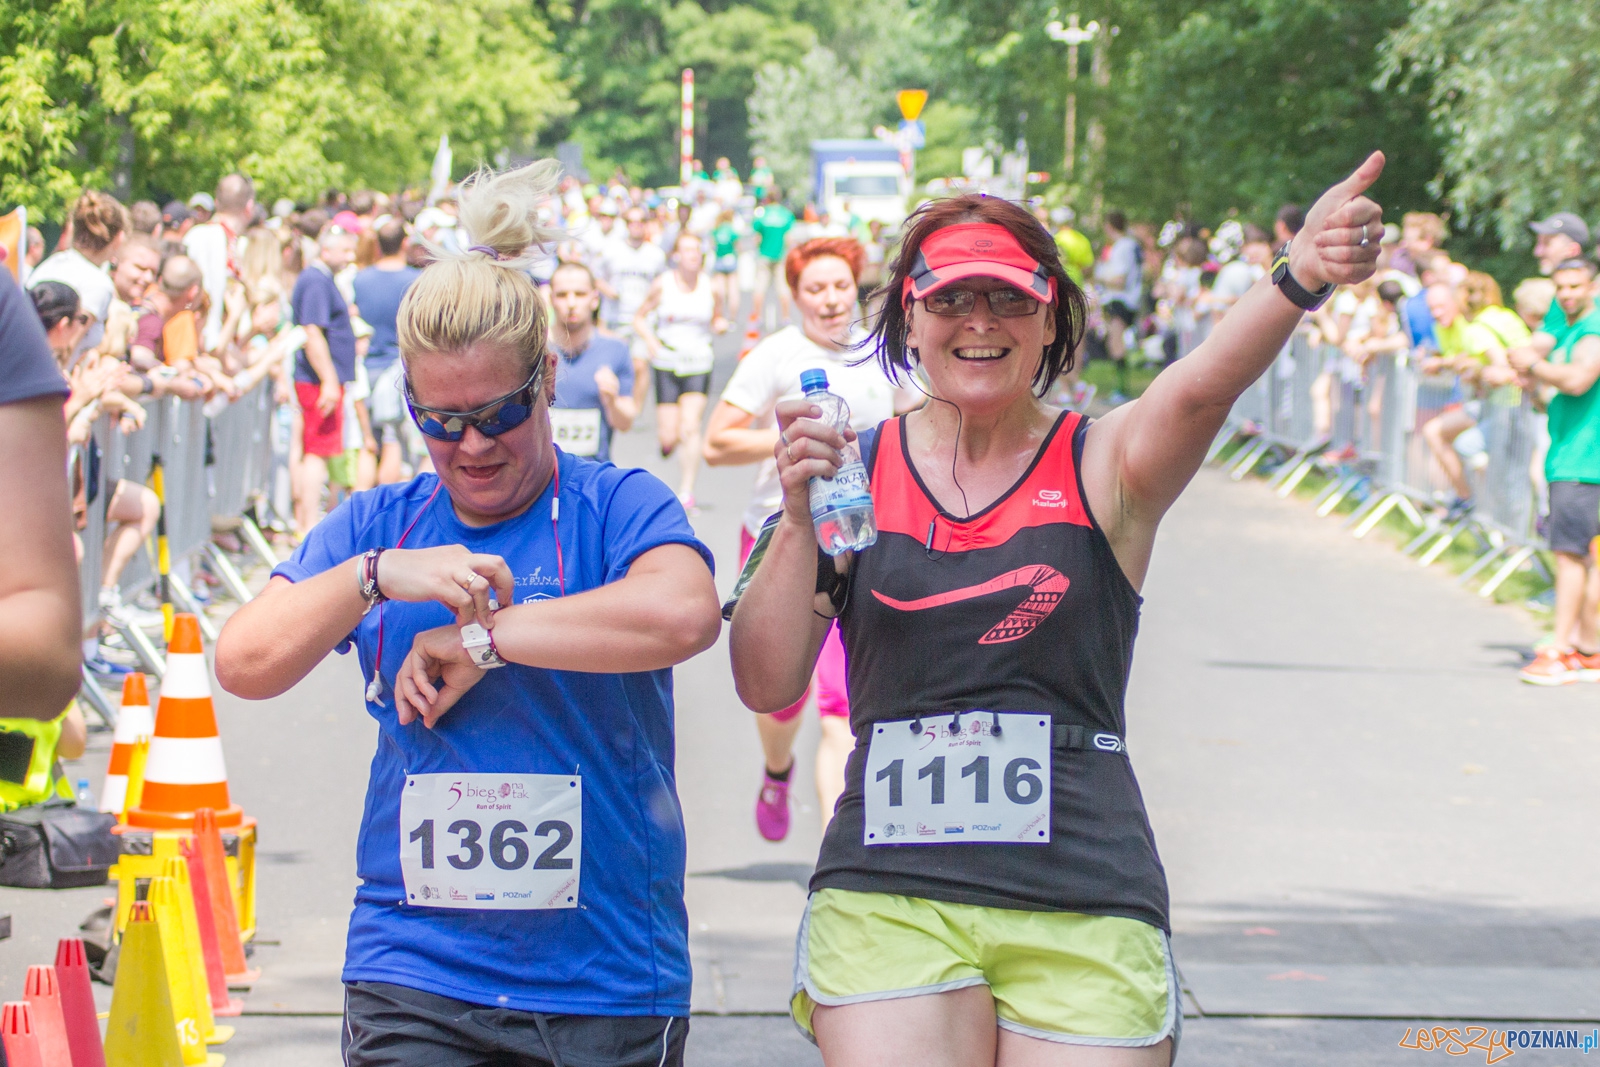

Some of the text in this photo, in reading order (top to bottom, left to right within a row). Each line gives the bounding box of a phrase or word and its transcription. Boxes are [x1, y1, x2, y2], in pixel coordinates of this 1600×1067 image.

[919, 725, 936, 751] 5
[512, 789, 529, 799] tak
[876, 755, 1043, 807] 1116
[447, 781, 497, 810] 5 bieg
[496, 803, 512, 811] Spirit
[409, 819, 574, 871] 1362
